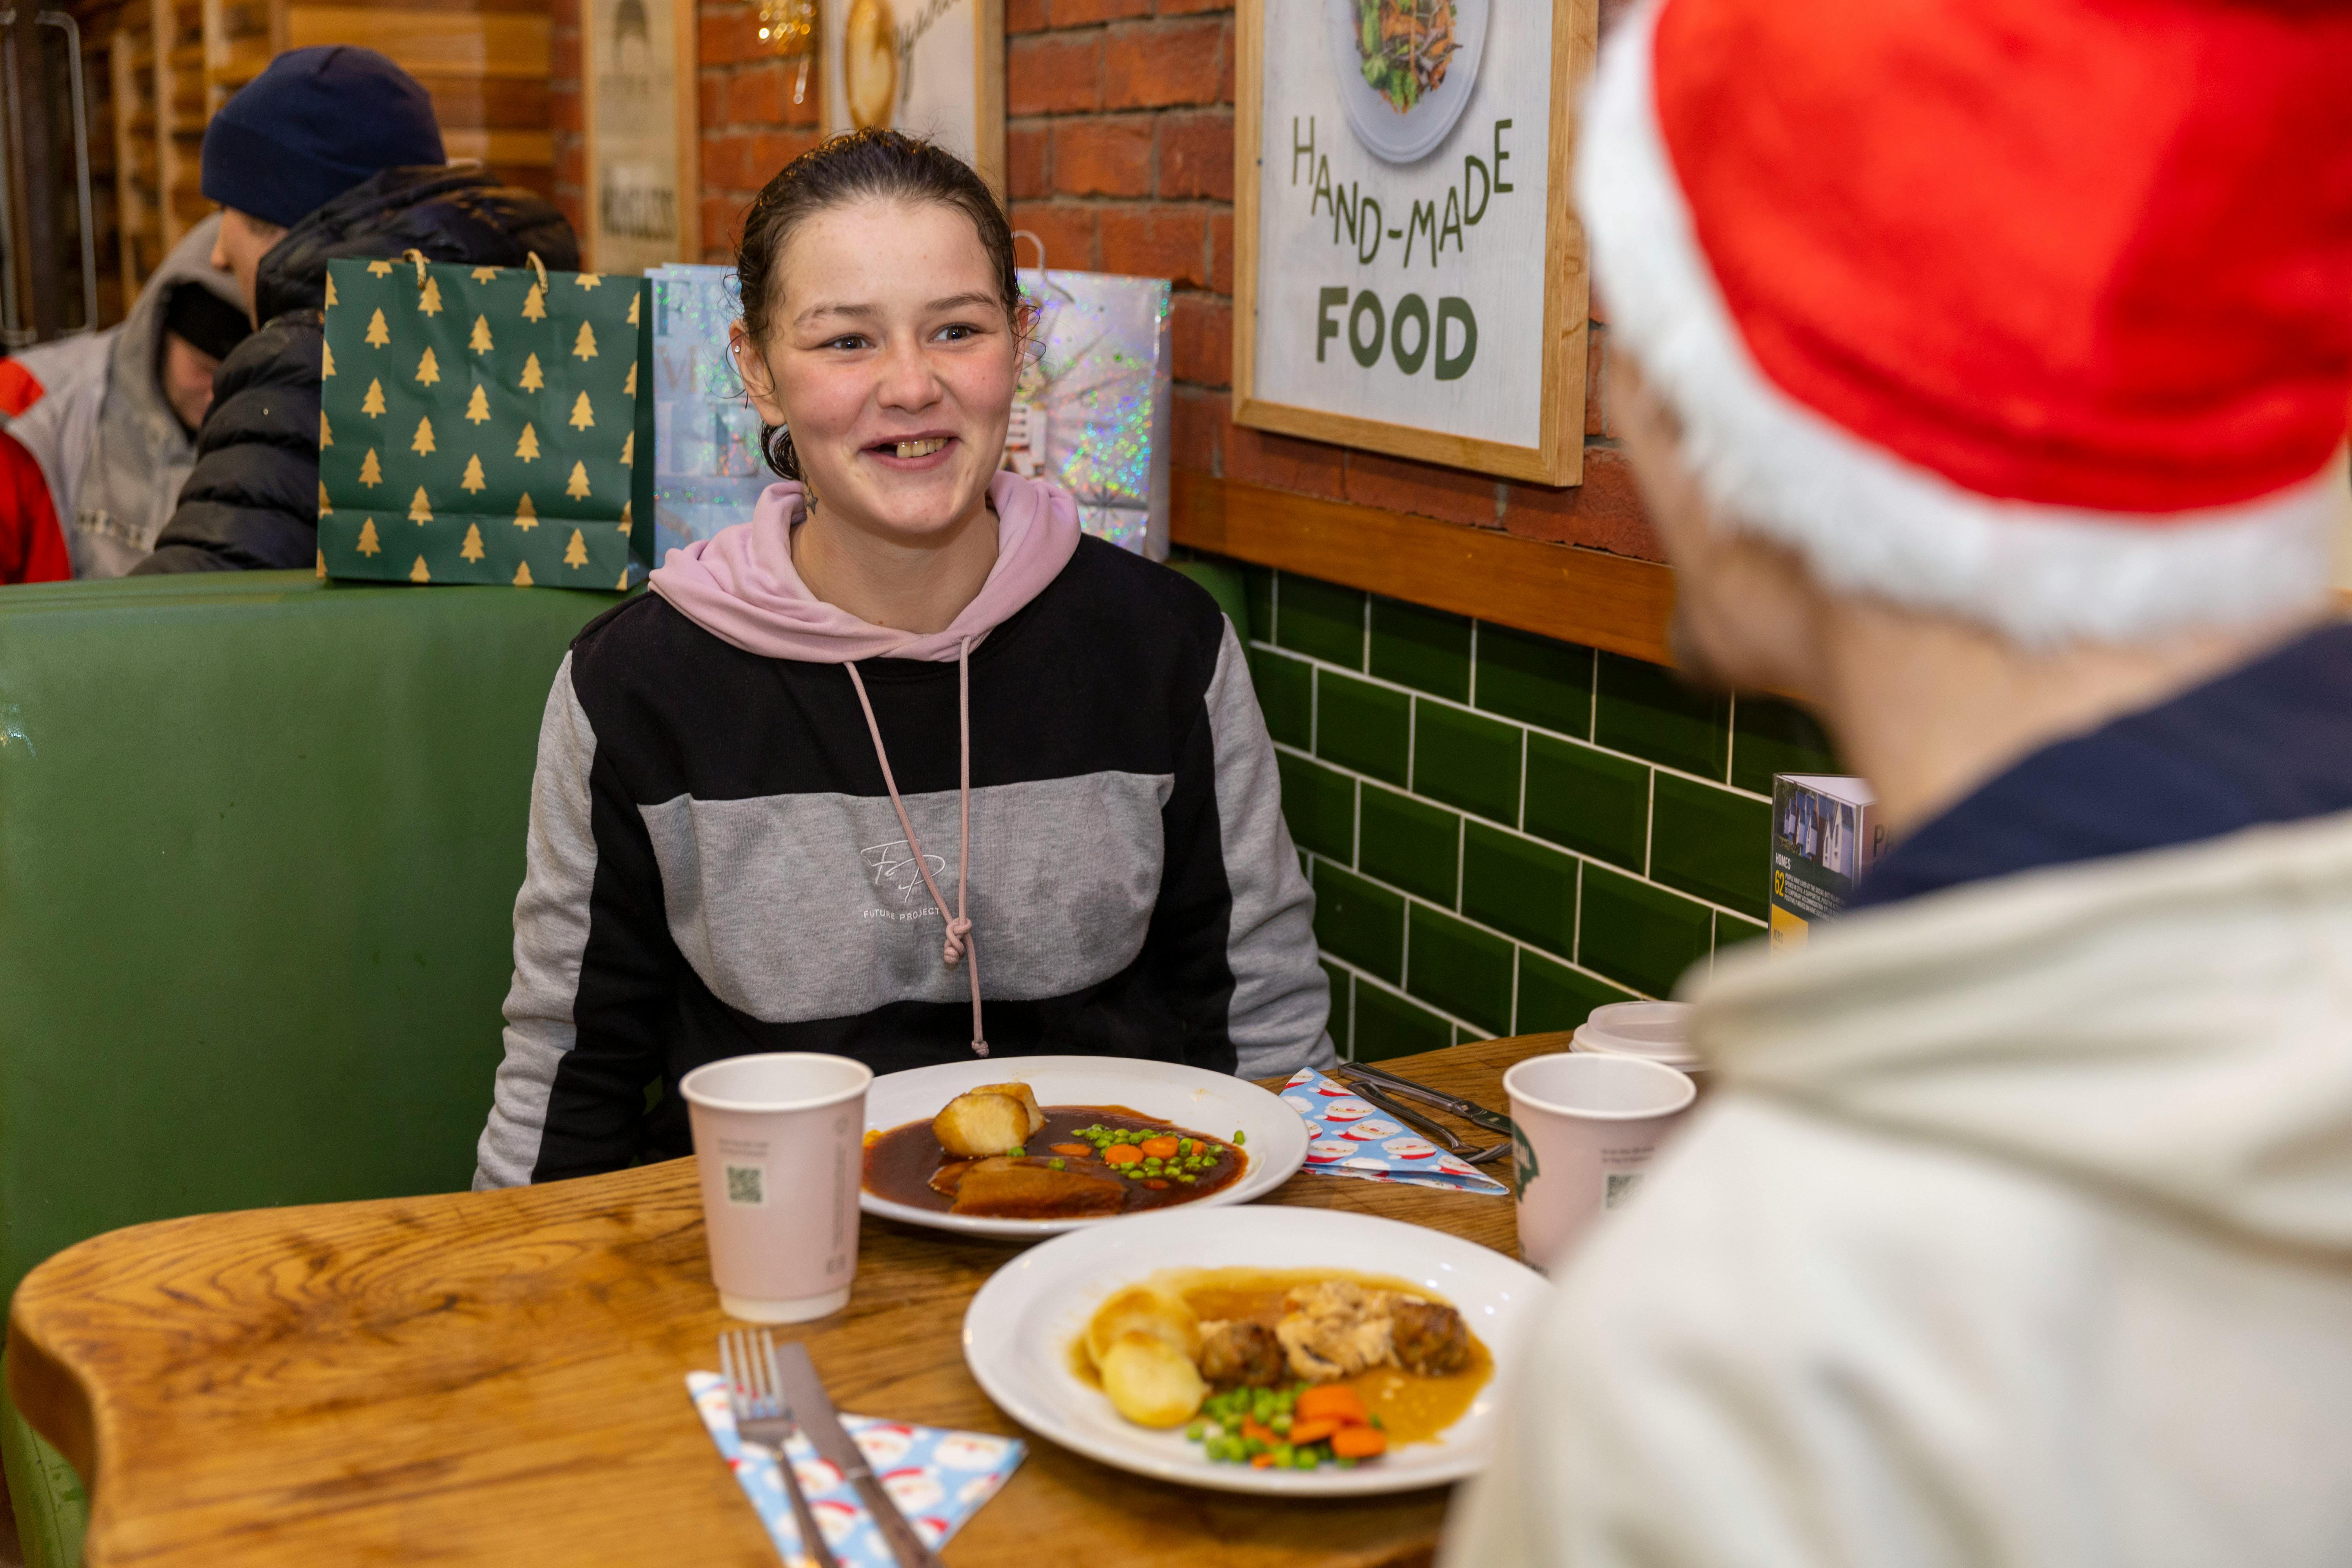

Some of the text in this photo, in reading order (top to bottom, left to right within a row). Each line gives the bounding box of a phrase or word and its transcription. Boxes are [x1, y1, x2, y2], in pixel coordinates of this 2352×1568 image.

[1292, 116, 1514, 269] HAND-MADE
[1317, 286, 1478, 381] FOOD
[1776, 852, 1791, 869] HOMES
[1775, 870, 1785, 897] 62
[863, 907, 939, 921] FUTURE PROJECT
[1773, 928, 1784, 944] JOBS
